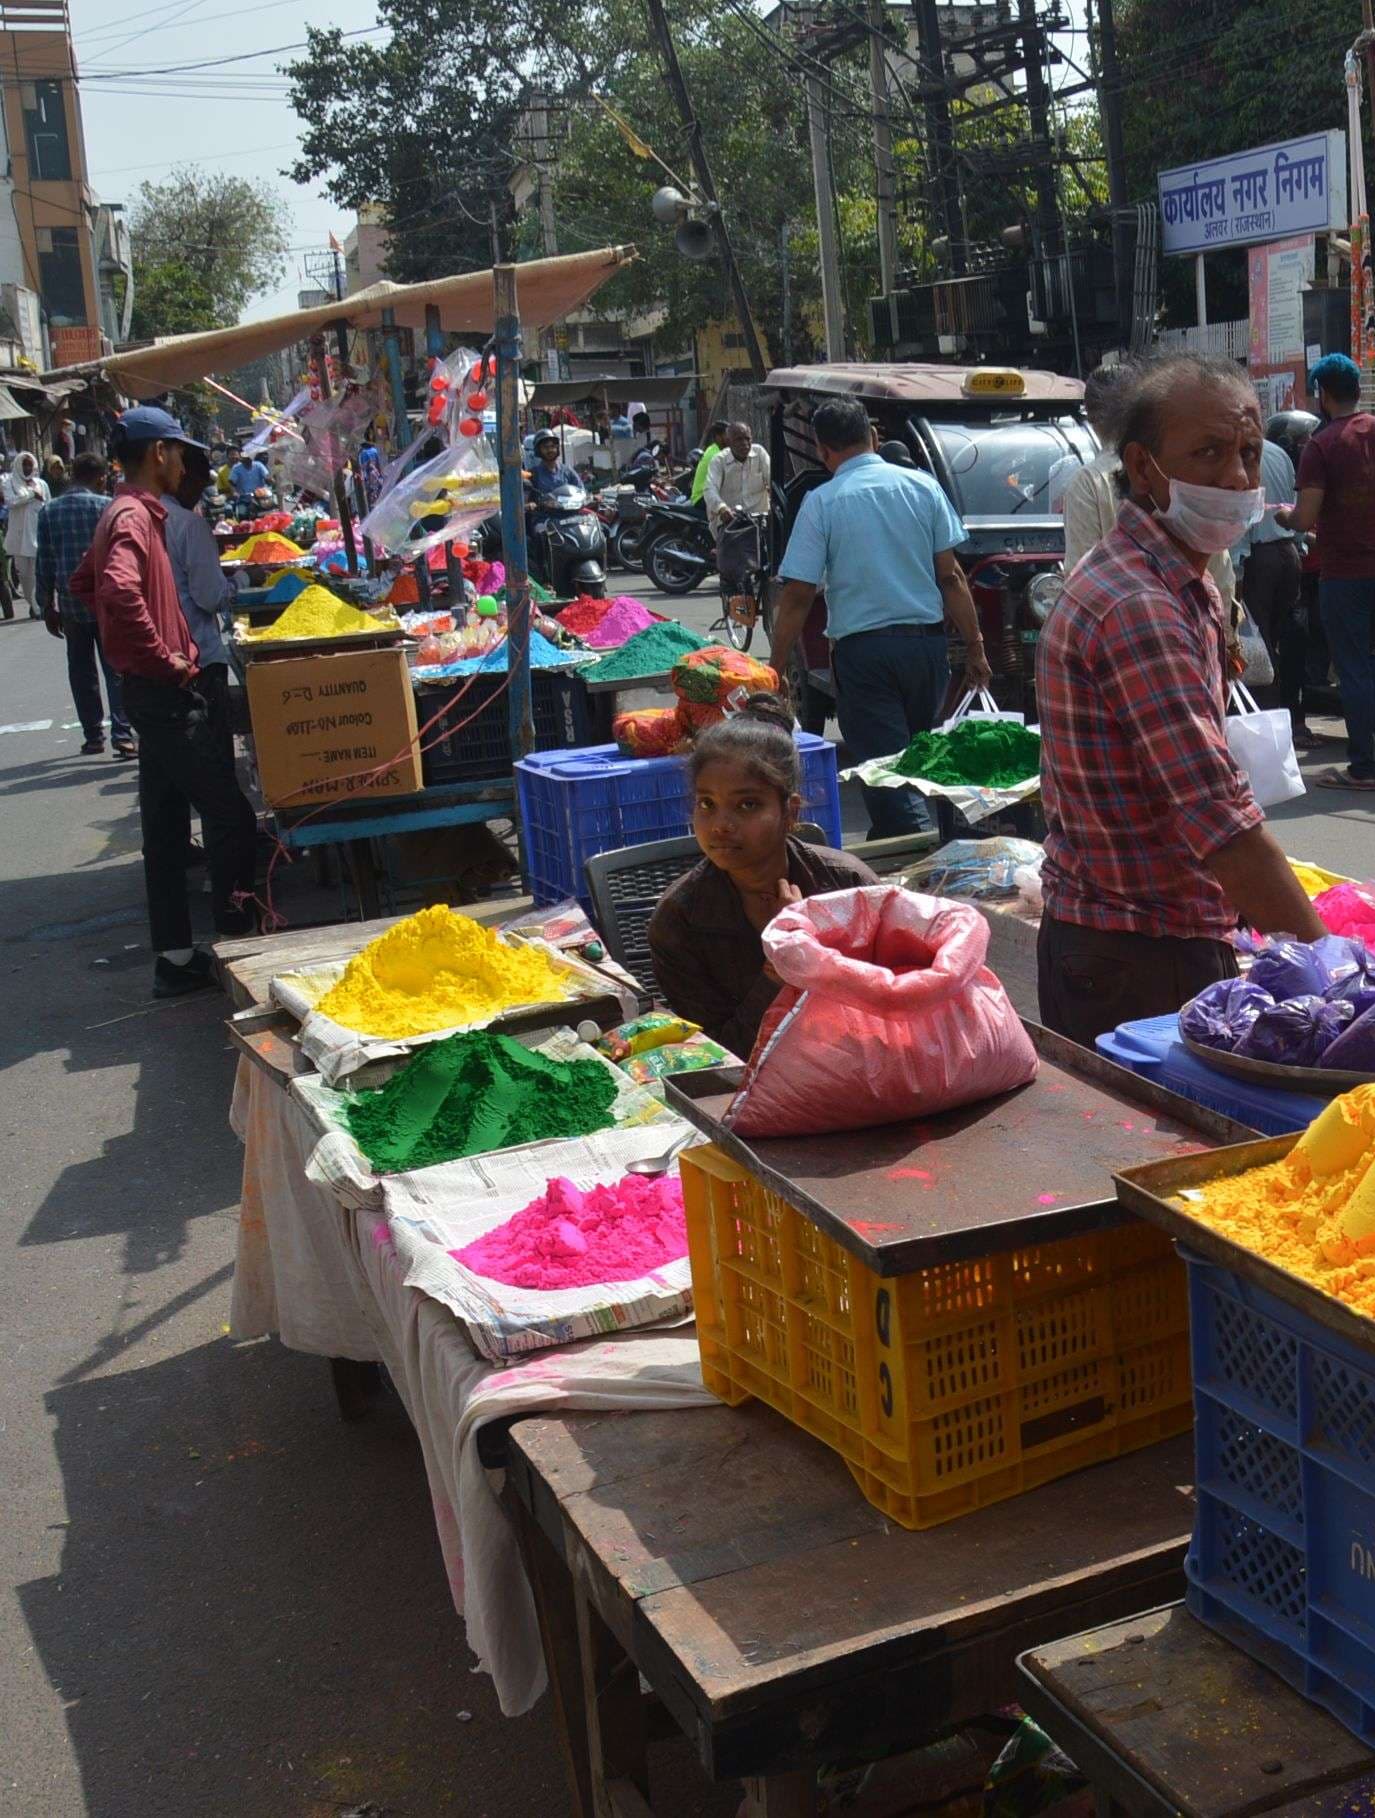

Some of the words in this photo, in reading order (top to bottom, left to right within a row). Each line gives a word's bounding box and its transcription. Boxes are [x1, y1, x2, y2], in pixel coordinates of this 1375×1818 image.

[1163, 171, 1226, 226] कार्यालय
[1231, 168, 1269, 212] नगर
[1274, 152, 1325, 205] निगम
[1204, 219, 1228, 240] अलवर
[319, 680, 367, 697] QUANTITY
[337, 712, 372, 725] Colour
[353, 745, 377, 759] ITEM
